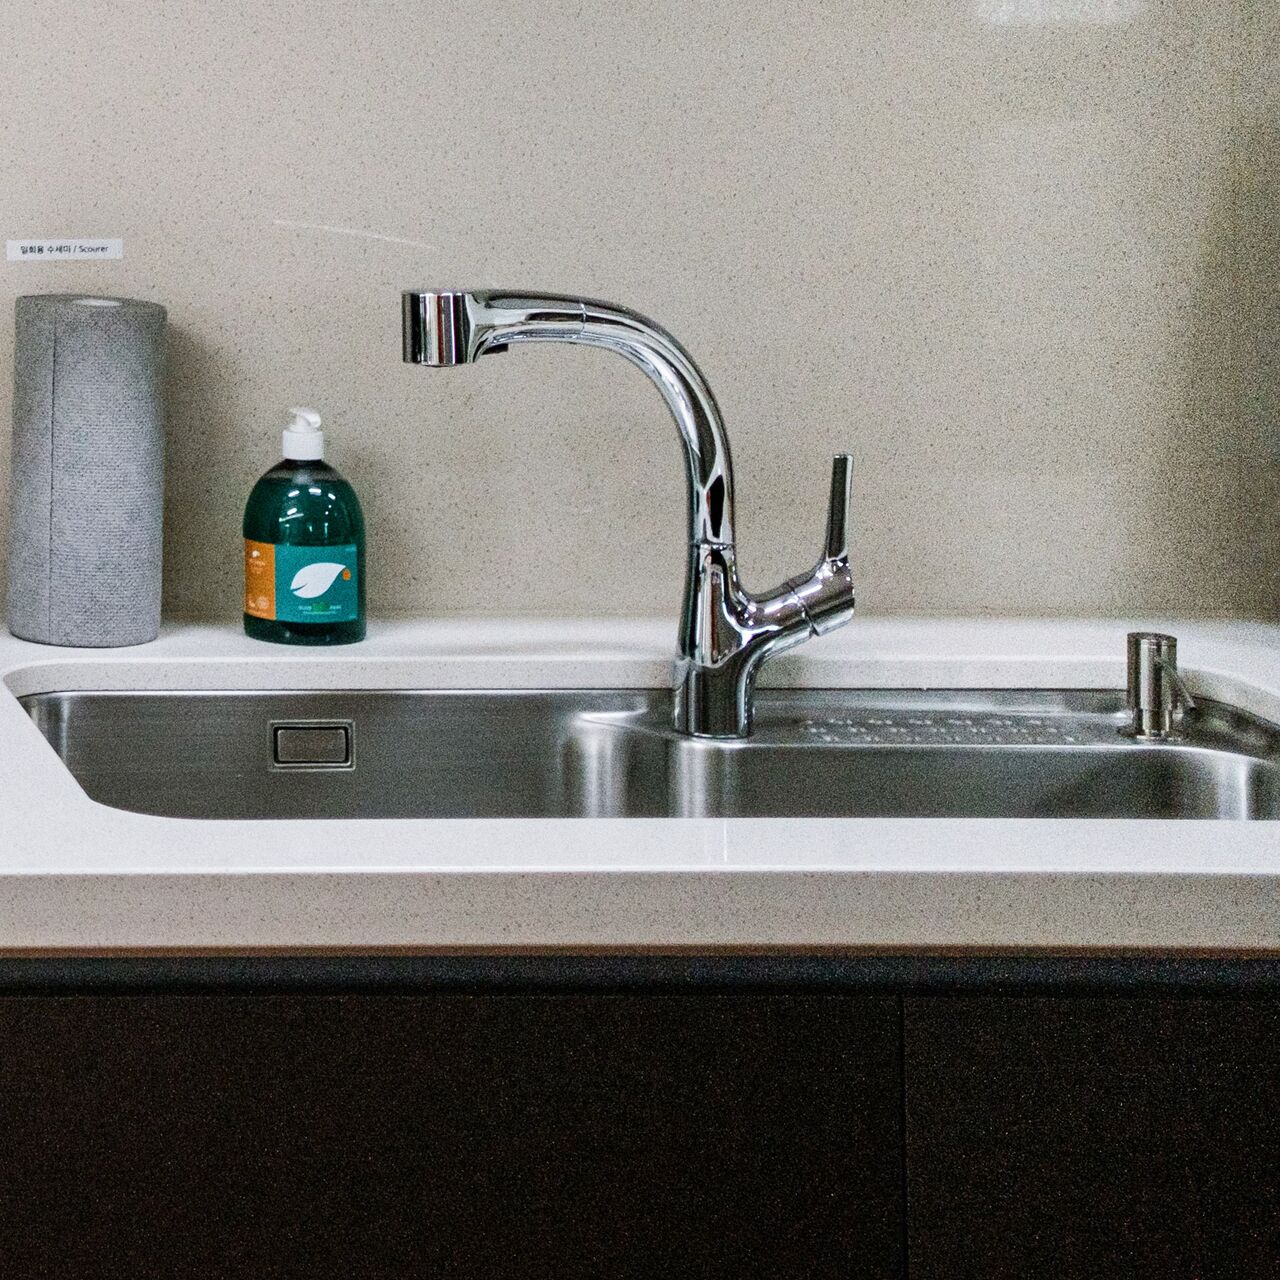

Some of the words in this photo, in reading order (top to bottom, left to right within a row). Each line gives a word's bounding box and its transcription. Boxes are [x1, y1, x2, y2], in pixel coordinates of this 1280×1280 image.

[20, 245, 44, 255] 일회용
[47, 245, 71, 254] 수세미
[79, 245, 109, 254] Scourer
